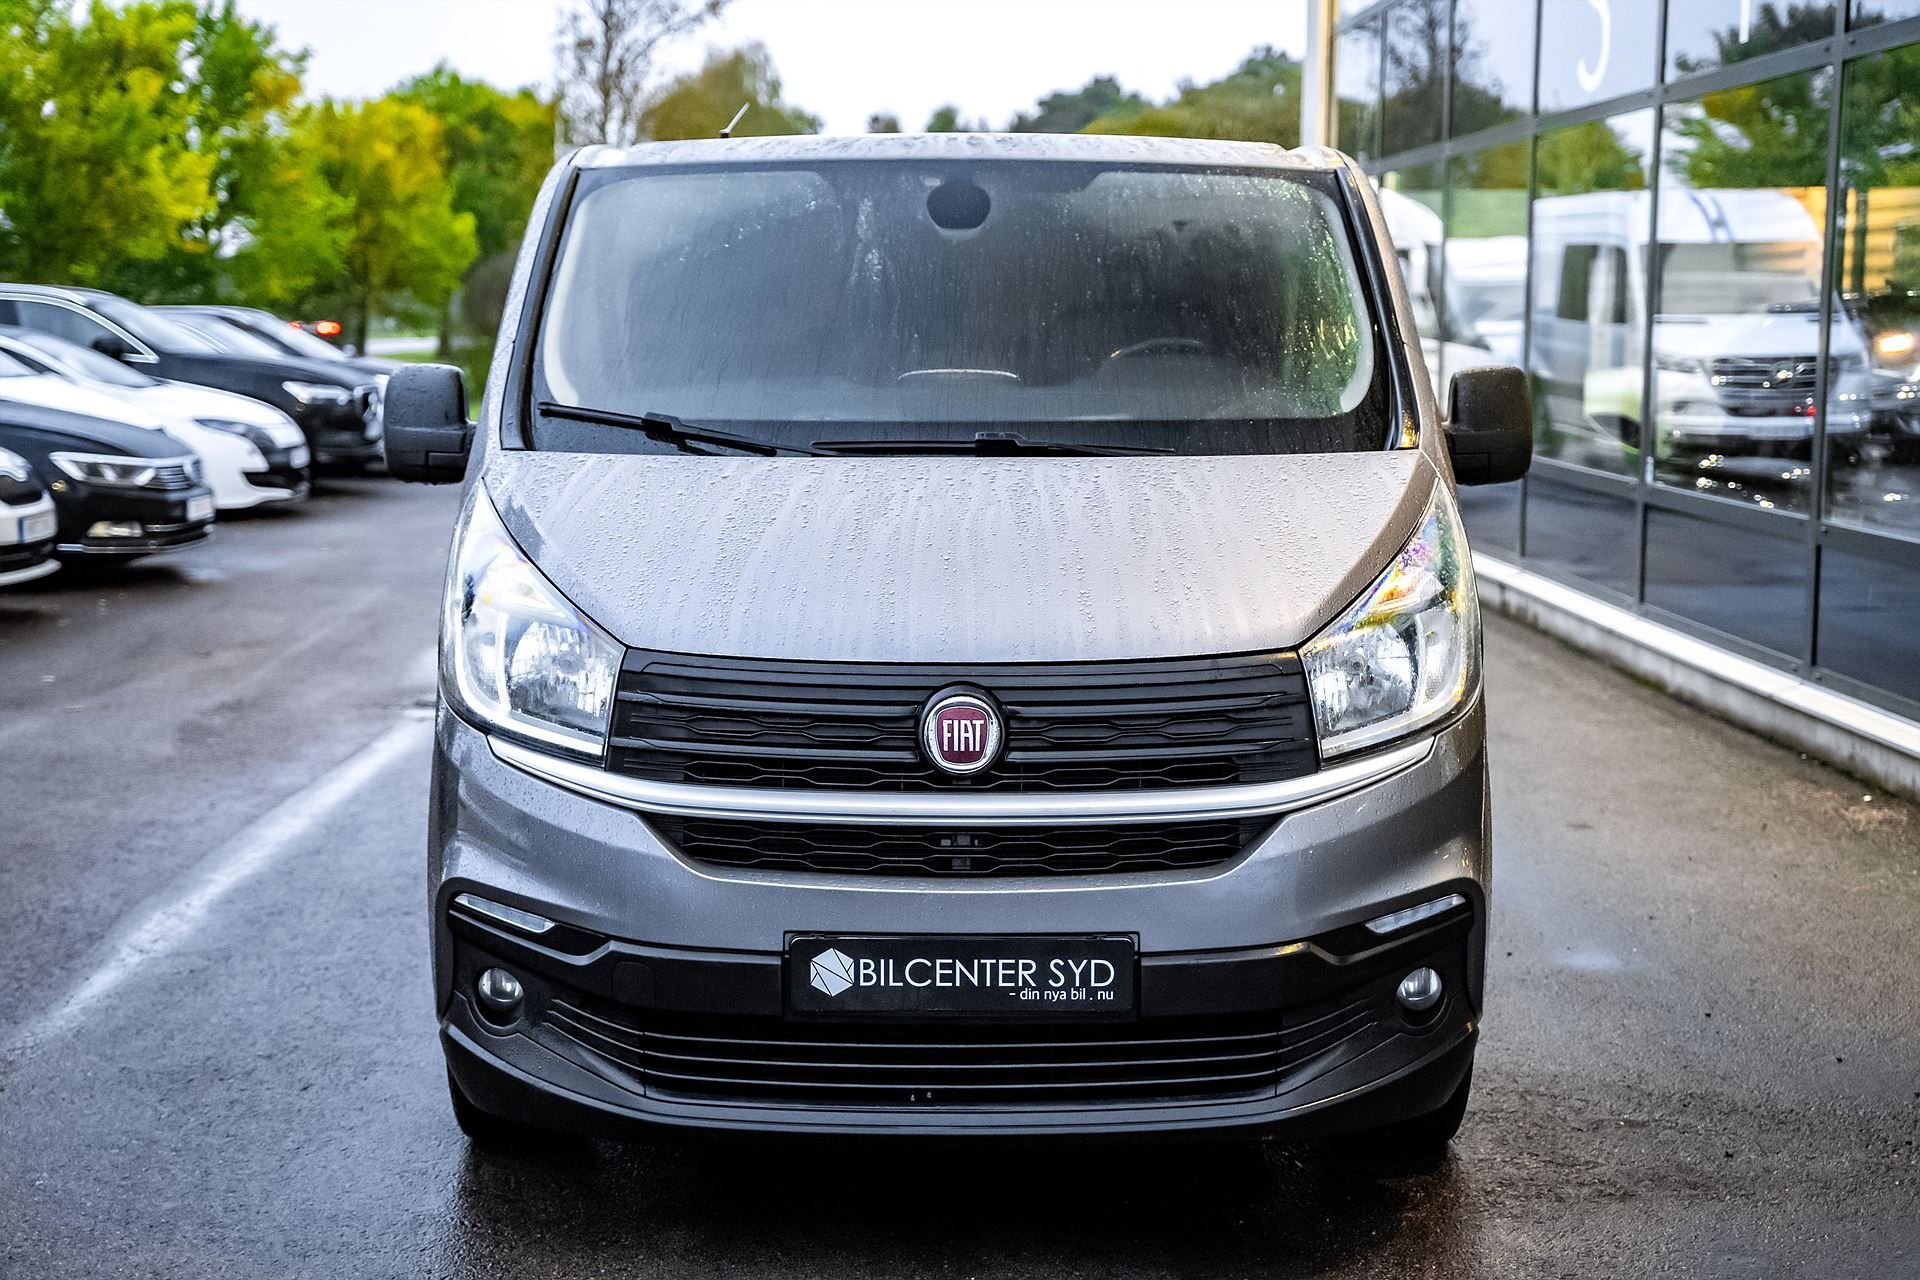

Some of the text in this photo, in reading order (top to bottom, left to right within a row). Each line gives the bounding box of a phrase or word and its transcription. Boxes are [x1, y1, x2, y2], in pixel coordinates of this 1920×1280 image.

[942, 719, 985, 752] FIAT
[859, 958, 1115, 987] BILCENTER SYD
[1019, 988, 1040, 1001] din
[1043, 990, 1067, 1003] nya
[1097, 990, 1114, 1001] nu
